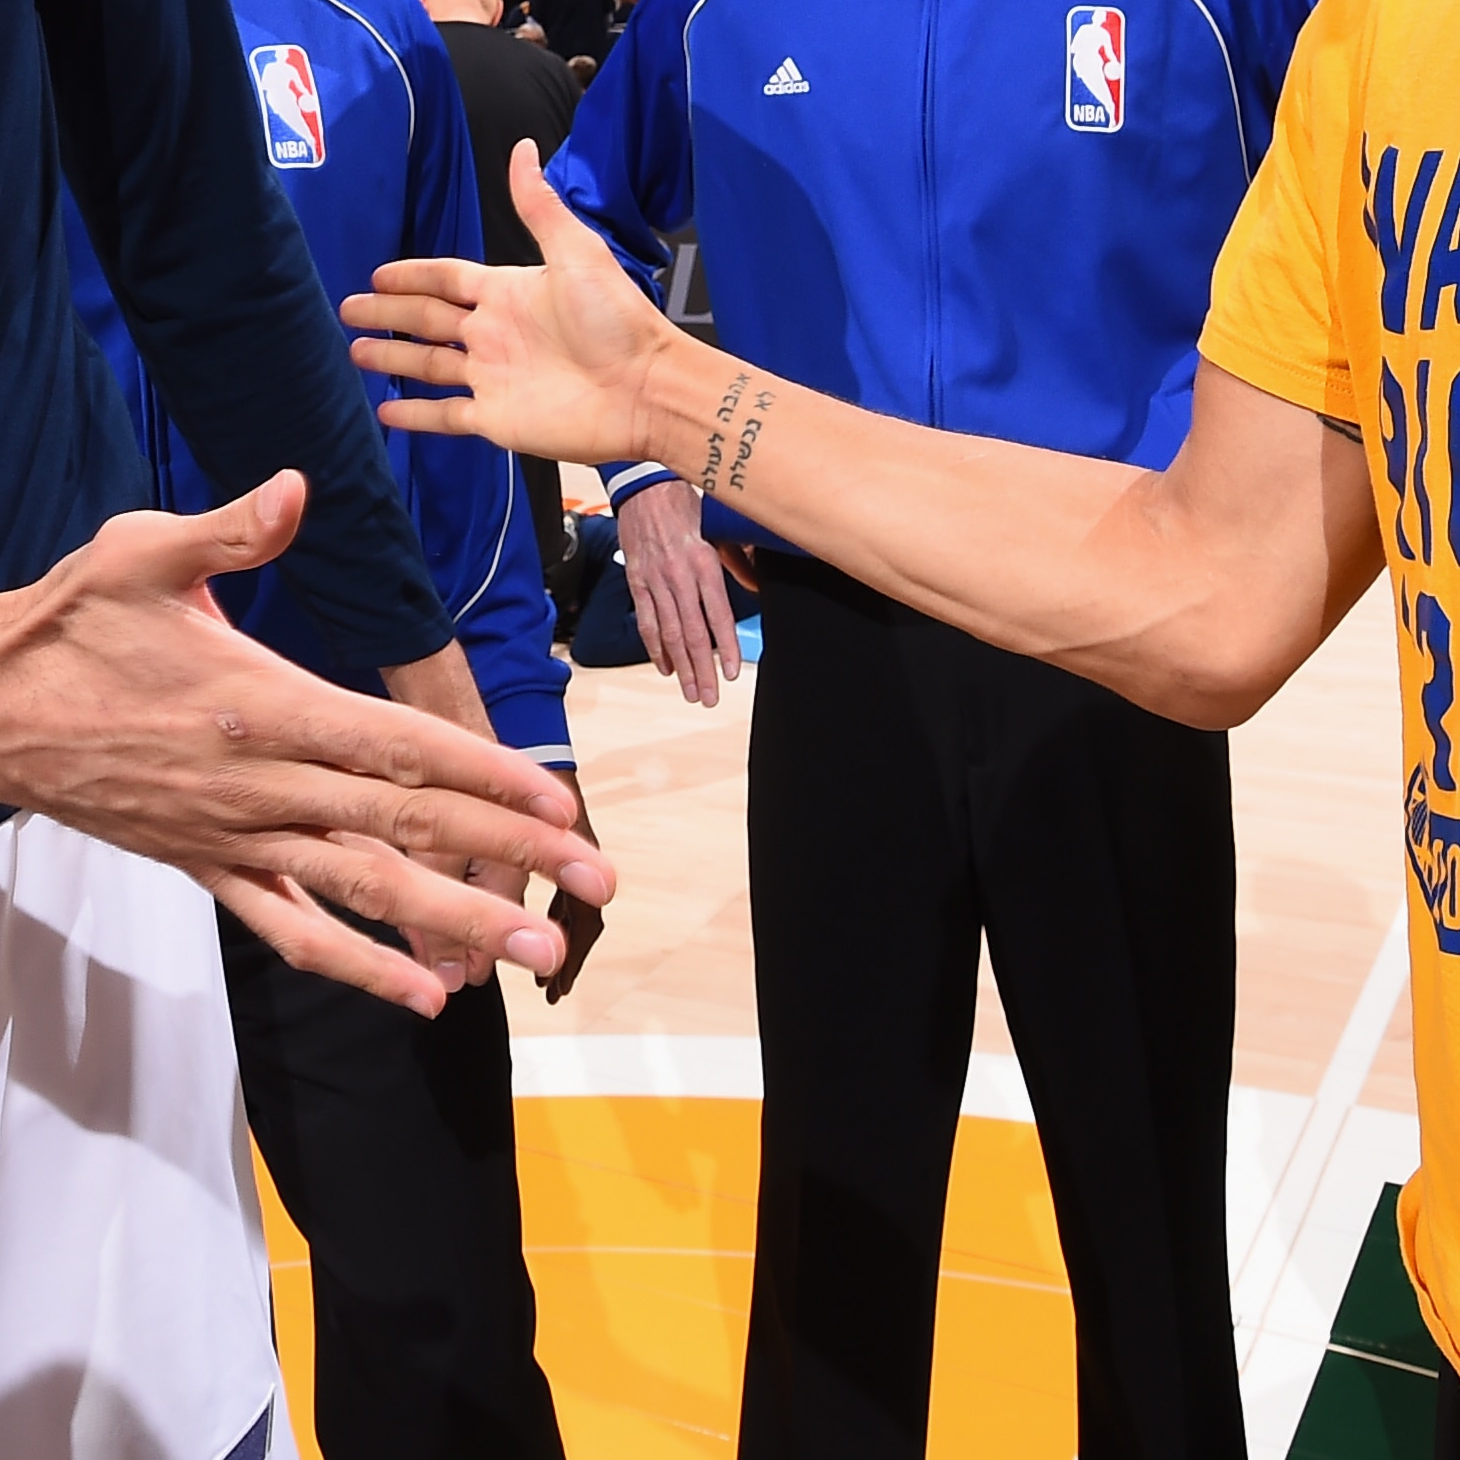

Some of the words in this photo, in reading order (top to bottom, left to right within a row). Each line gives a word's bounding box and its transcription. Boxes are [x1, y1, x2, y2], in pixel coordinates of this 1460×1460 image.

[763, 80, 811, 96] adidas
[1073, 102, 1106, 124] NBA
[274, 139, 309, 160] NBA
